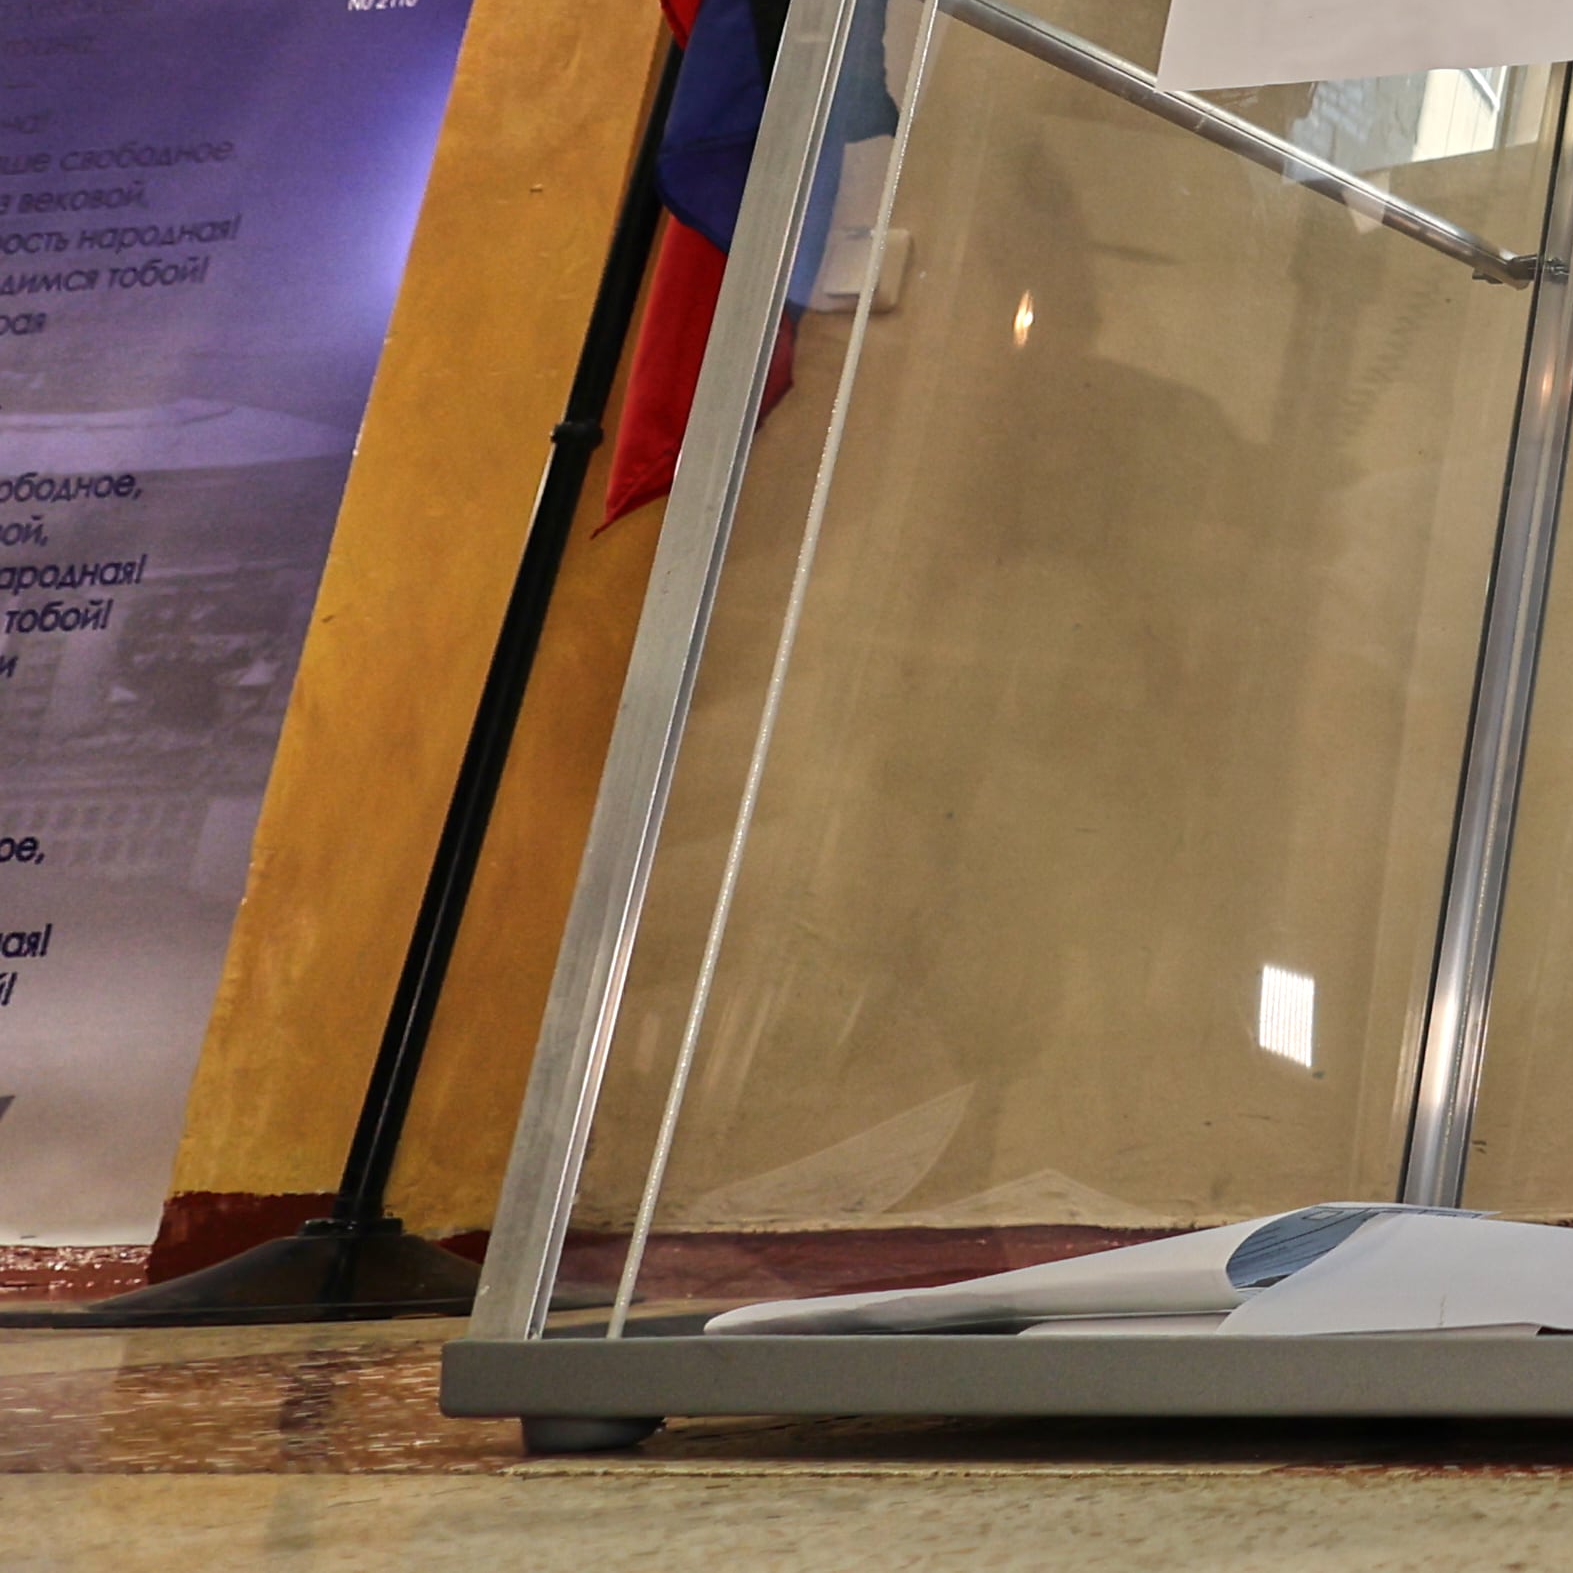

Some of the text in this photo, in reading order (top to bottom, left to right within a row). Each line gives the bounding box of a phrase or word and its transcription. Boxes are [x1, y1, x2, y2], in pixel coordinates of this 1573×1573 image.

[77, 213, 242, 254] народная!
[108, 255, 209, 289] тобой!
[5, 599, 115, 634] тобой!
